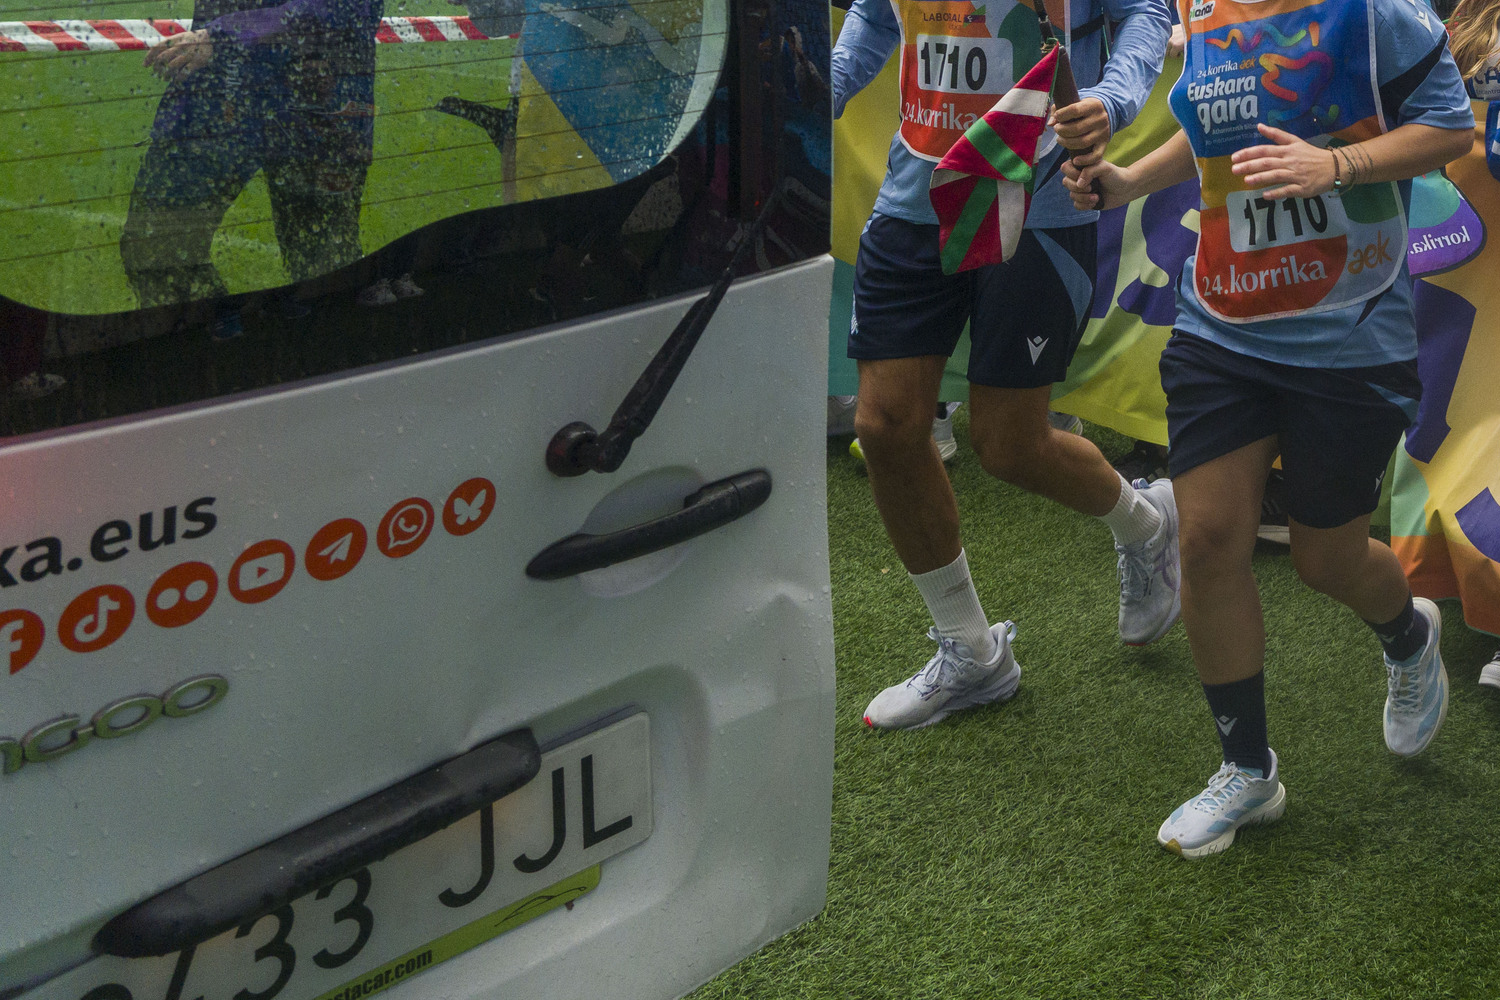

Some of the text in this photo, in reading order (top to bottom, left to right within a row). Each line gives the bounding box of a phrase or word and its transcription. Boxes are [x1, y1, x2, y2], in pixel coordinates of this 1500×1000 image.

[921, 42, 987, 91] 1710
[1187, 73, 1256, 101] Euskara
[904, 98, 979, 131] 24.korrika
[1197, 94, 1259, 134] gara
[1244, 195, 1328, 246] 1710
[1202, 230, 1392, 297] 24.korrika aek
[438, 753, 634, 909] JJL
